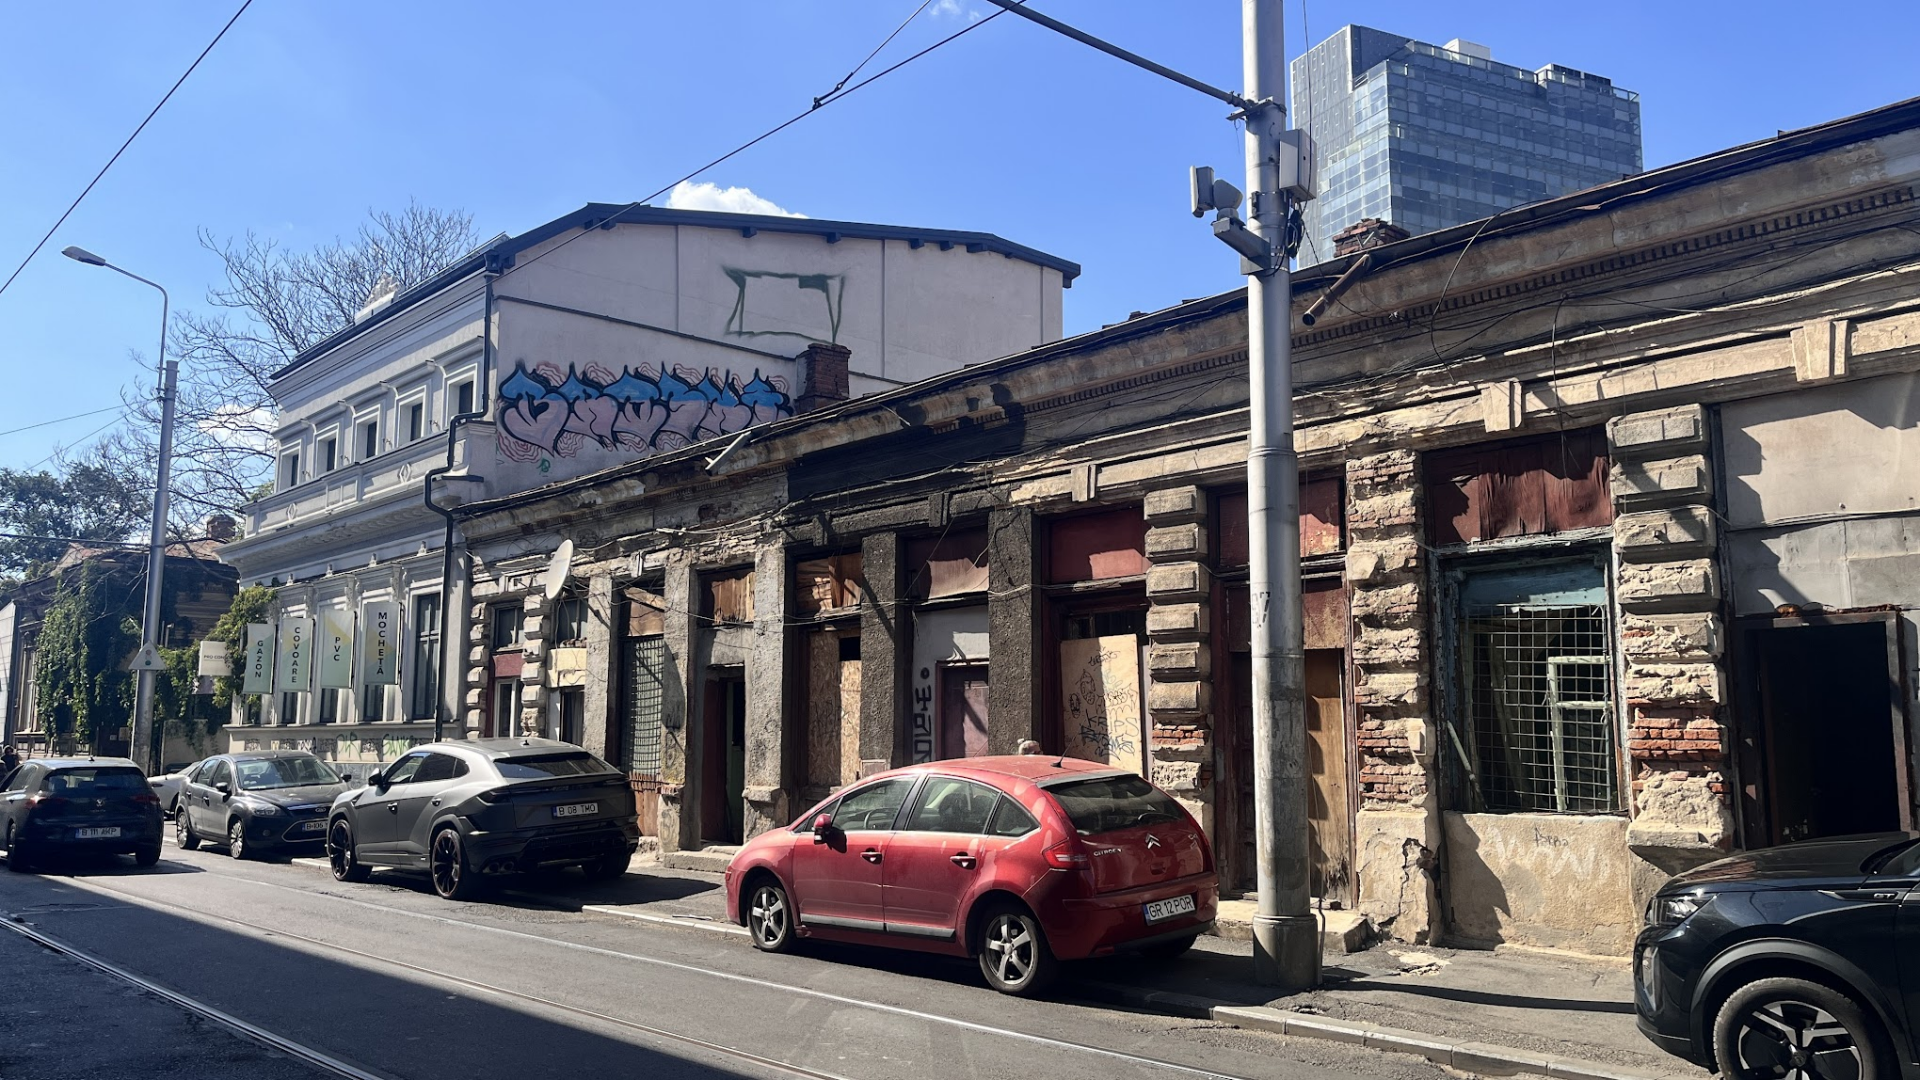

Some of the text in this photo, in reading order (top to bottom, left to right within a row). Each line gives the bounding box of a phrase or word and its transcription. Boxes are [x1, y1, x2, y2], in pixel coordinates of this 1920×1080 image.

[254, 640, 264, 678] GAZON
[291, 626, 301, 683] COVOARE
[333, 636, 342, 662] PVC
[376, 611, 388, 675] MOCHETĂ
[559, 806, 565, 815] B
[567, 805, 577, 814] 08
[1148, 896, 1194, 918] GR 12 POR
